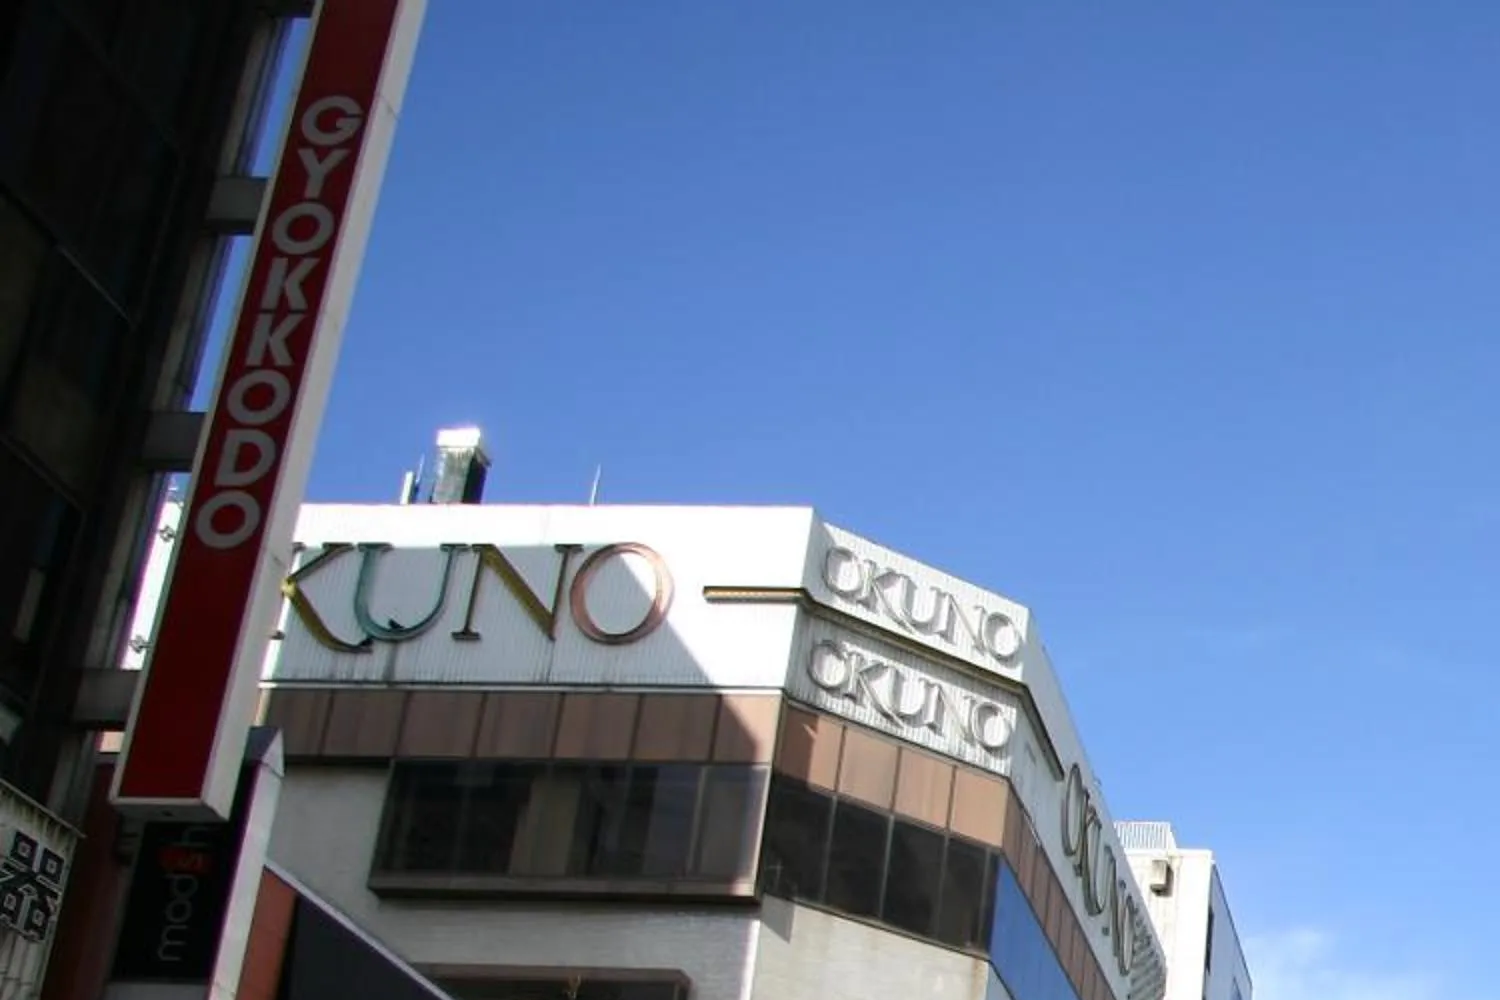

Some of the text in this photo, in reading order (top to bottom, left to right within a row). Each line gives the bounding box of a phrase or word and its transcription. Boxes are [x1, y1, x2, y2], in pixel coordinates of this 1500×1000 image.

[195, 95, 363, 550] GYOKKODO
[825, 544, 1025, 664] OKUNO
[808, 638, 1014, 757] OKUNO
